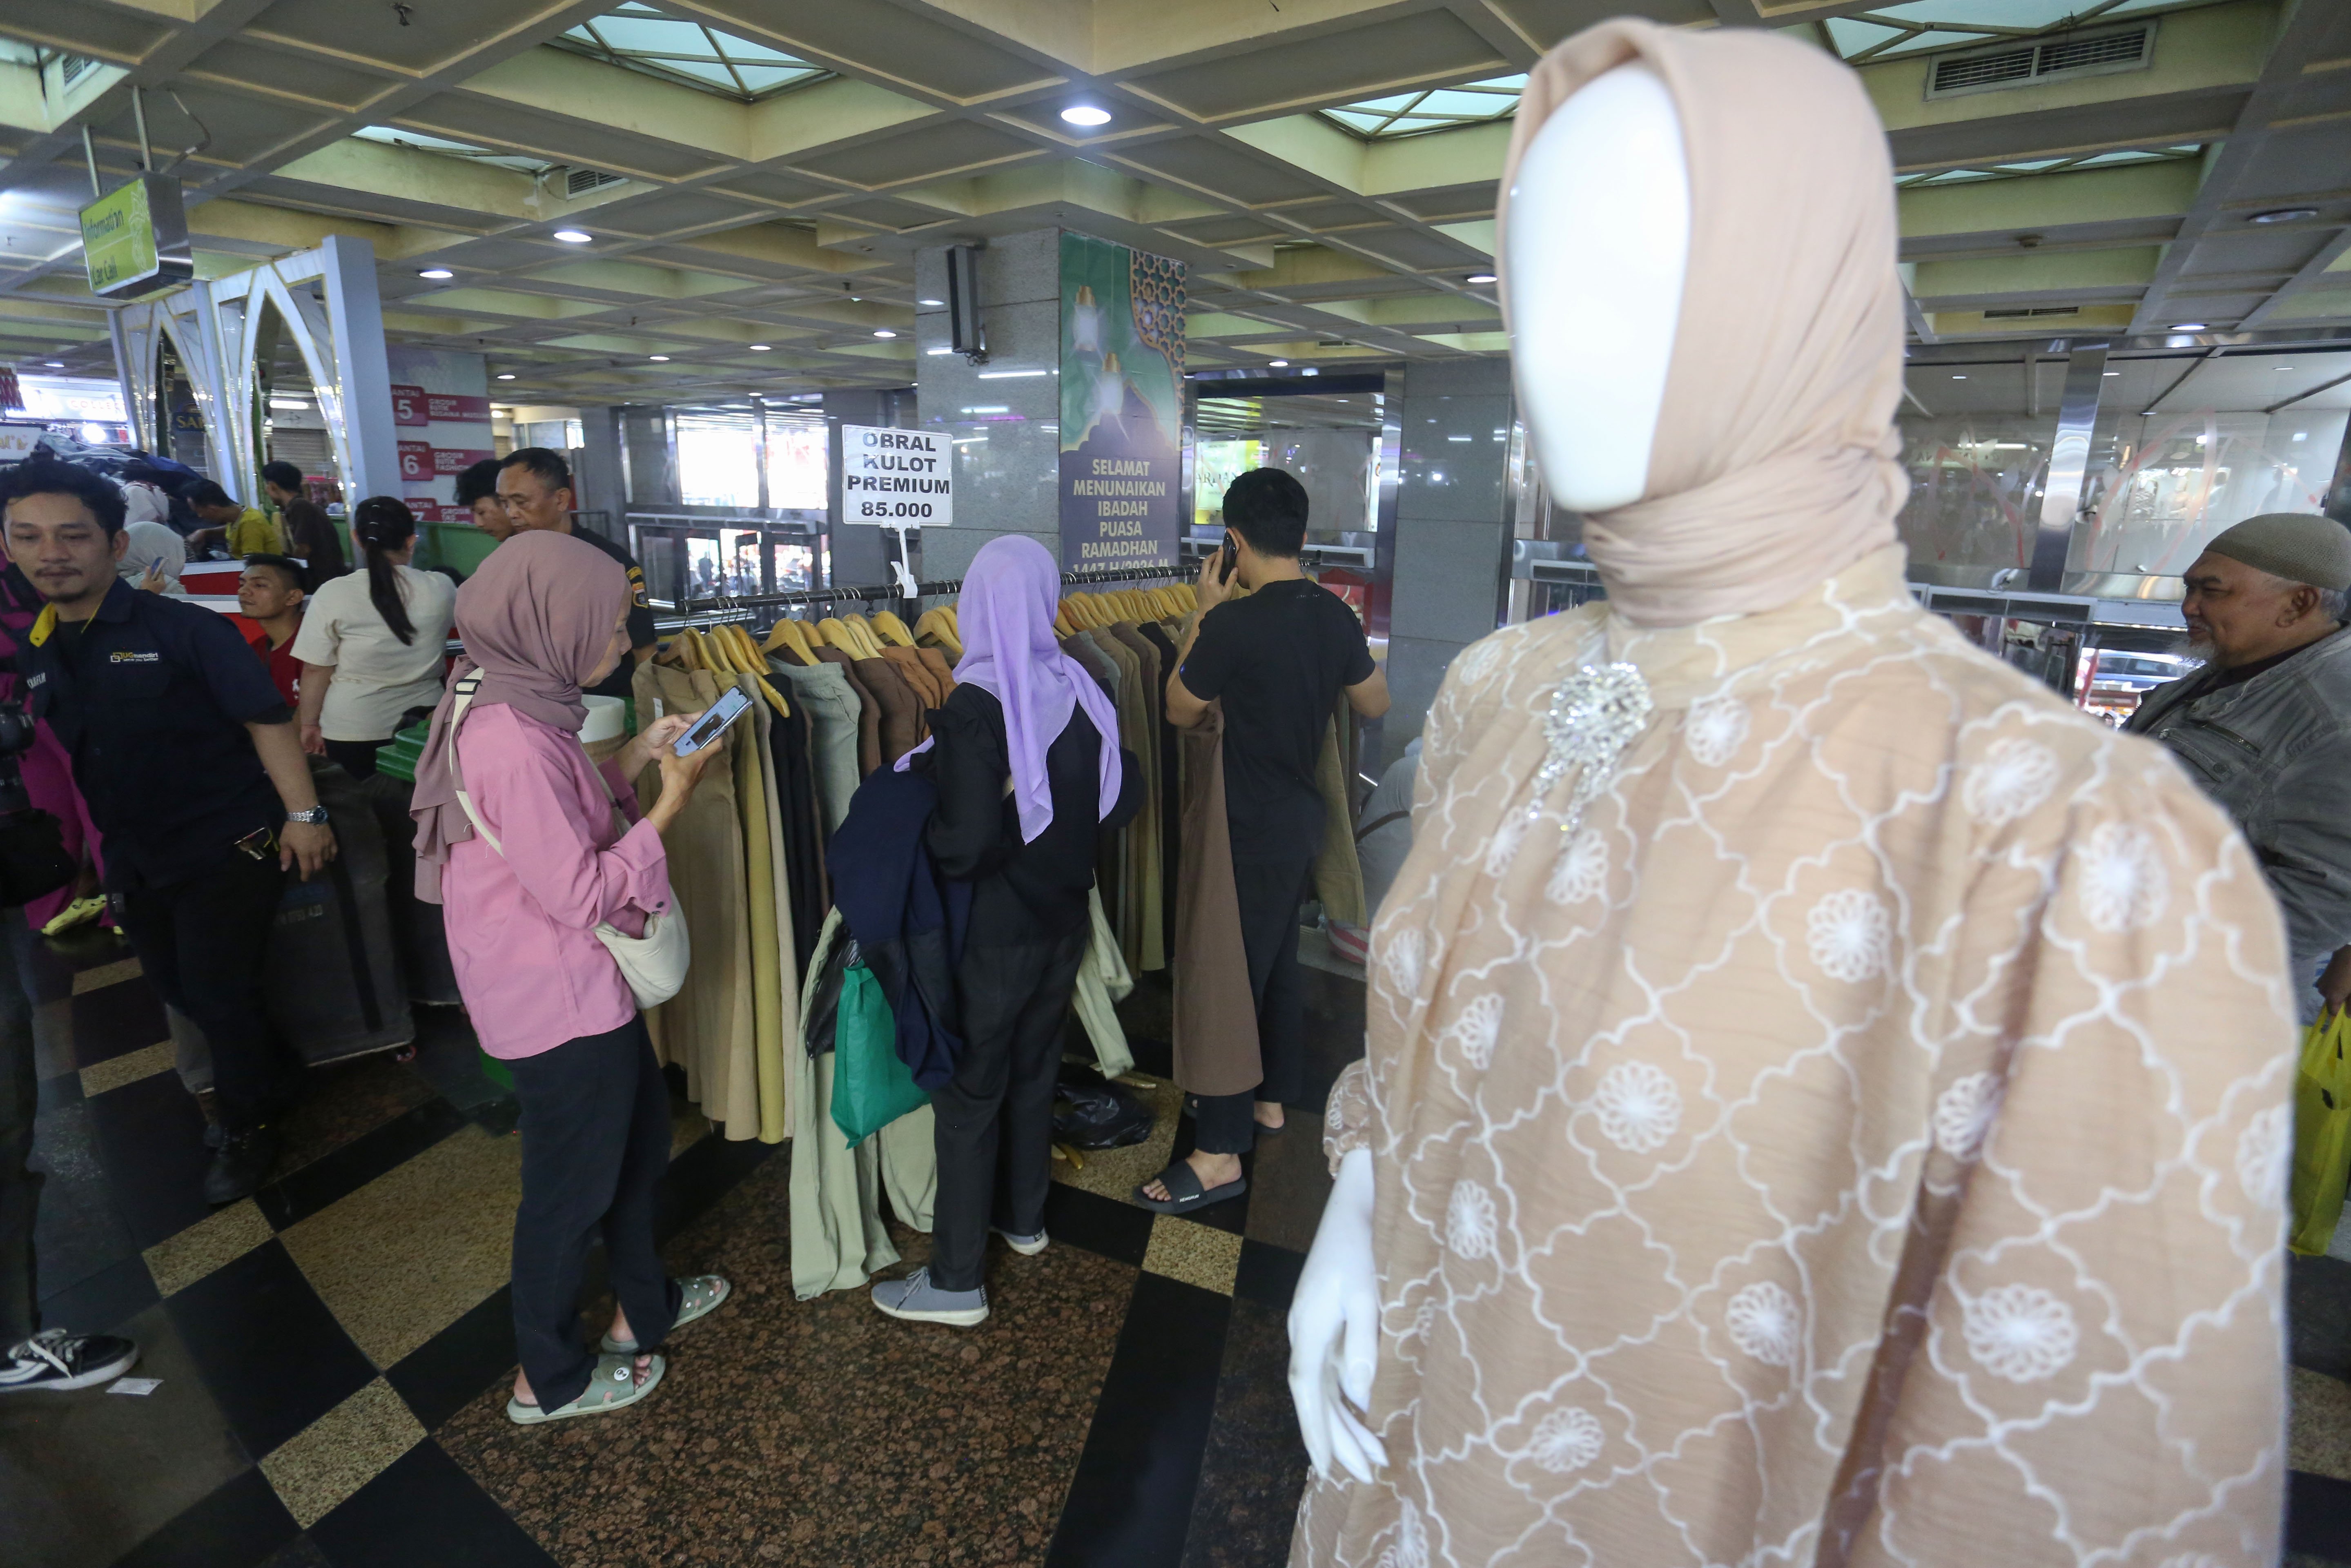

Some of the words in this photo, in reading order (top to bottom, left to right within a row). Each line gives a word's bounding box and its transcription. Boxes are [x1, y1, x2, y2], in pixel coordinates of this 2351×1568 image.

[392, 389, 420, 397] ANTAI
[398, 399, 413, 419] 5
[862, 432, 936, 452] OBRAL
[403, 454, 420, 475] 6
[863, 454, 936, 472] KULOT
[1092, 459, 1150, 476] SELAMAT
[847, 475, 949, 494] PREMIUM
[1073, 480, 1165, 496] MENUNAIKAN
[861, 501, 932, 517] 85.000
[1098, 501, 1148, 516] IBADAH
[1099, 521, 1142, 537] PUASA
[1082, 540, 1158, 558] RAMADHAN
